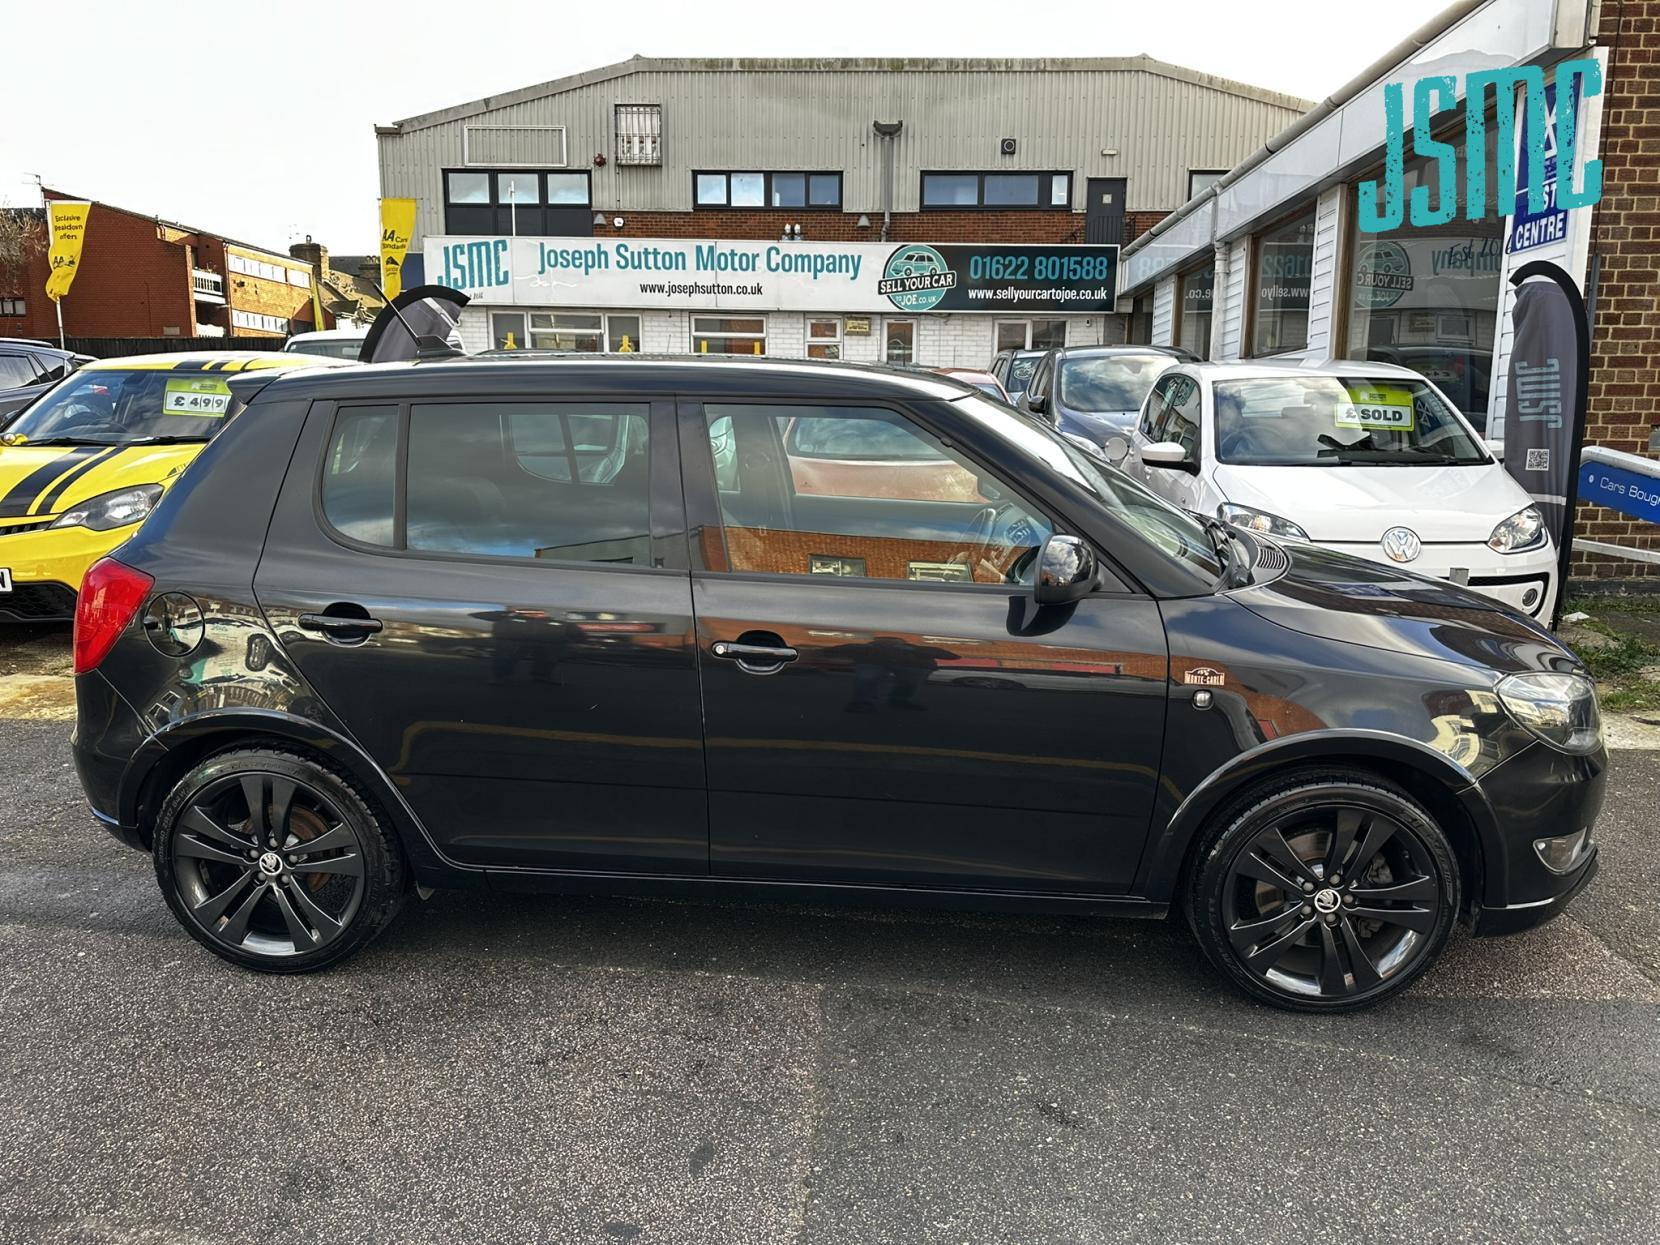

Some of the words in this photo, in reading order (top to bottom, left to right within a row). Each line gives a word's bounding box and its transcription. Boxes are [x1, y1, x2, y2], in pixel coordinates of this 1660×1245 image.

[1515, 213, 1565, 250] CENTRE
[437, 239, 509, 290] JSMC
[538, 242, 609, 275] Joseph
[615, 243, 686, 271] Sutton
[695, 244, 759, 272] Motor
[765, 245, 862, 281] Company
[969, 255, 1028, 280] 01622
[1033, 256, 1108, 281] 801588
[639, 281, 764, 297] www.josephsutton.co.uk
[880, 279, 903, 294] SELL
[904, 276, 931, 291] YOUR
[932, 273, 953, 288] CAR
[968, 285, 1107, 303] www.sellyourcartojoe.co.uk
[1514, 358, 1563, 429] JSMC
[1360, 408, 1403, 422] SOLD
[1600, 476, 1626, 495] Cars
